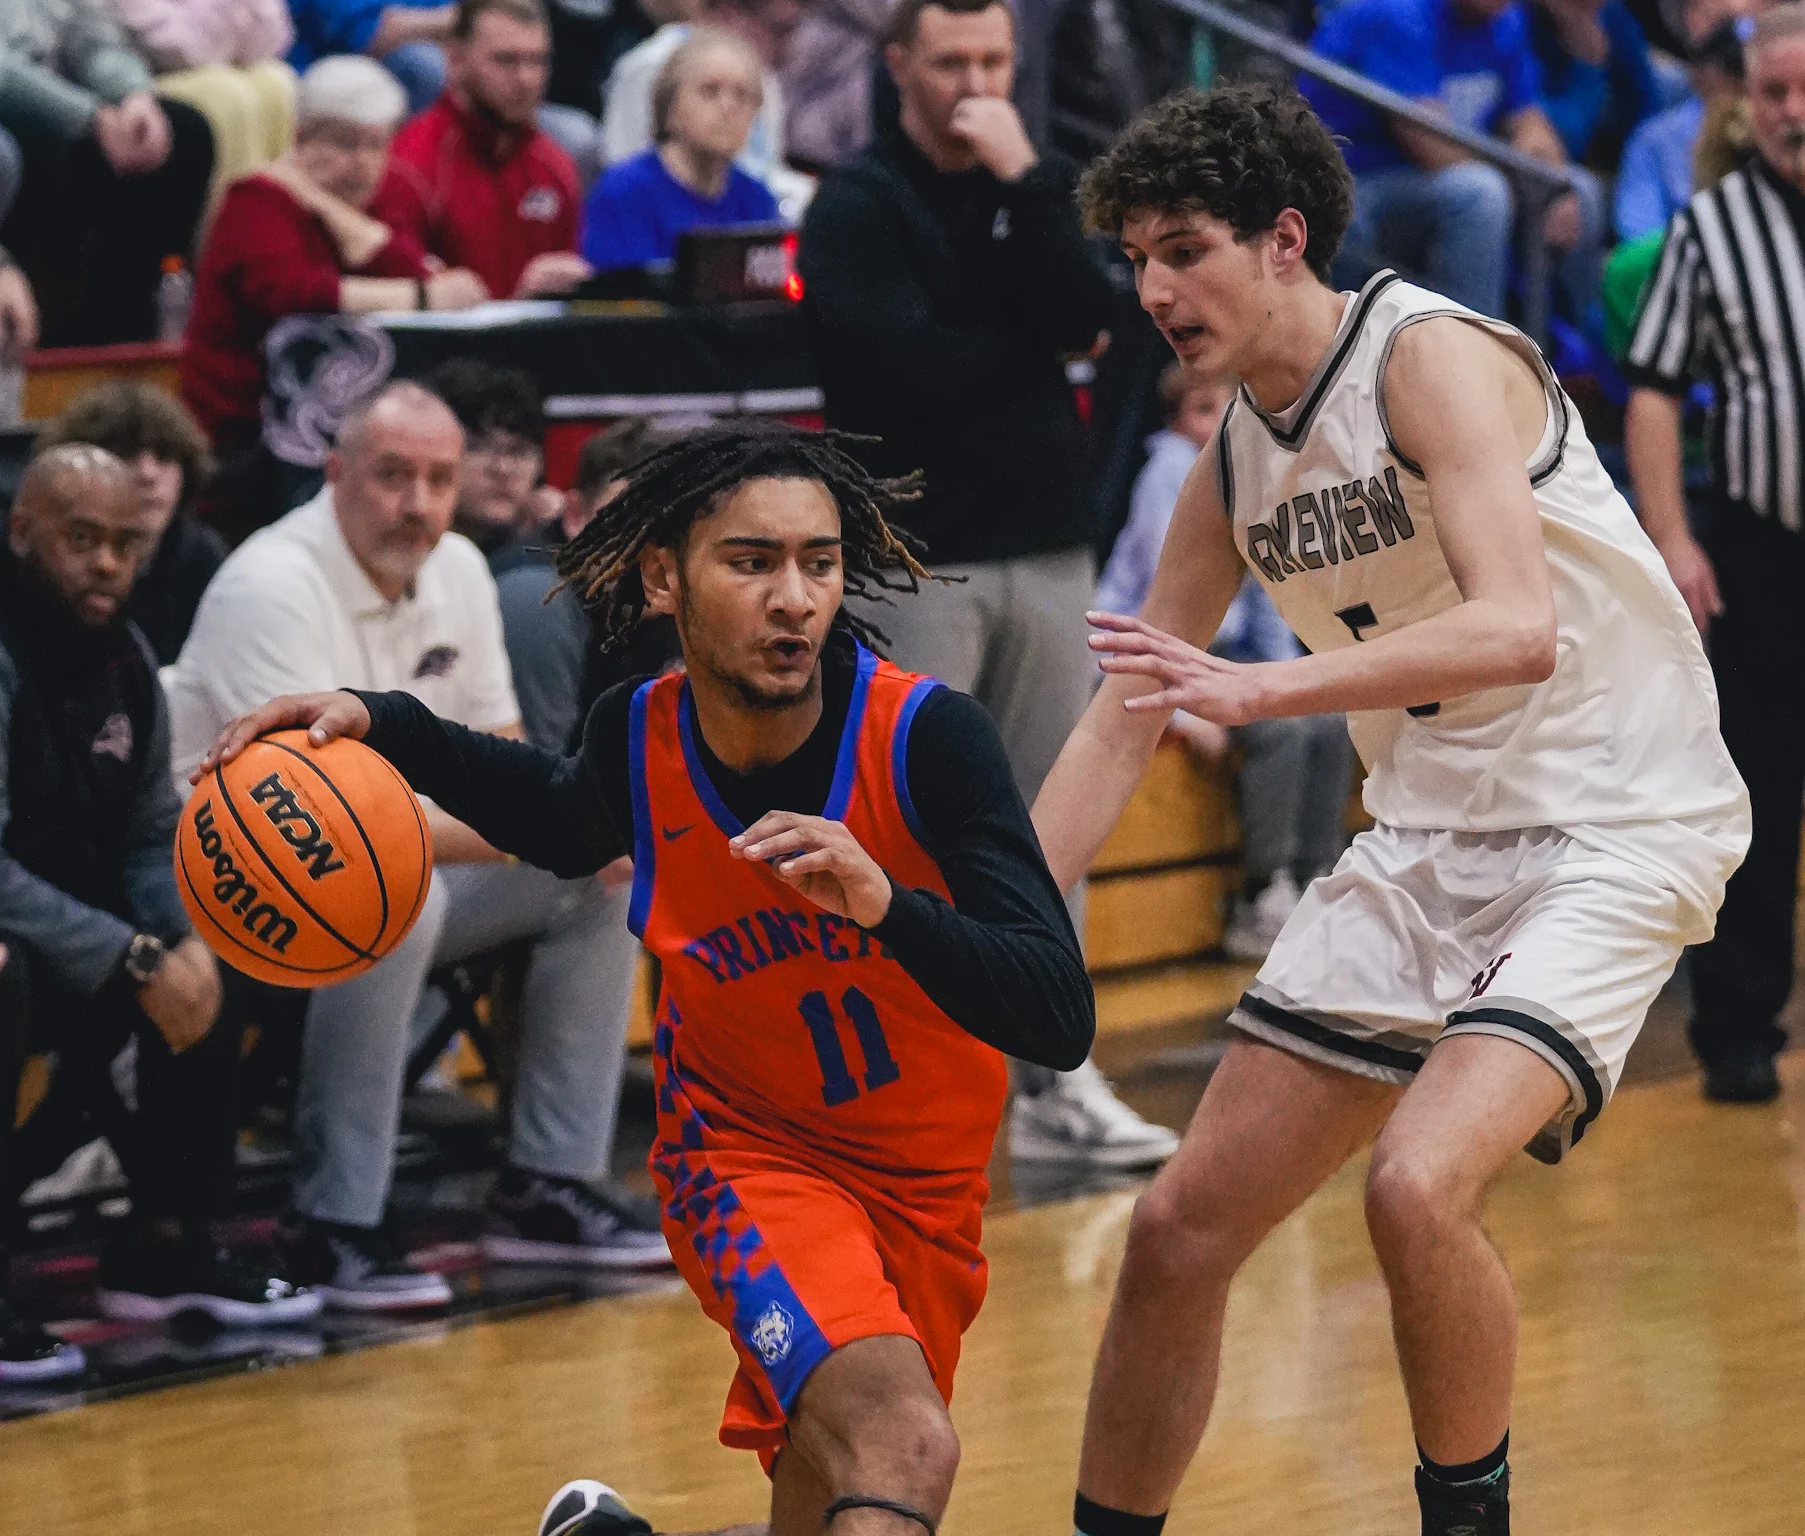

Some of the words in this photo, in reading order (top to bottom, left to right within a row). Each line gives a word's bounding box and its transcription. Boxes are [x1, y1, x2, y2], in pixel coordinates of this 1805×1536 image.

[194, 798, 297, 954] Wilson
[248, 772, 345, 880] NCAA
[682, 907, 897, 984] PRINCET
[797, 985, 900, 1107] 11
